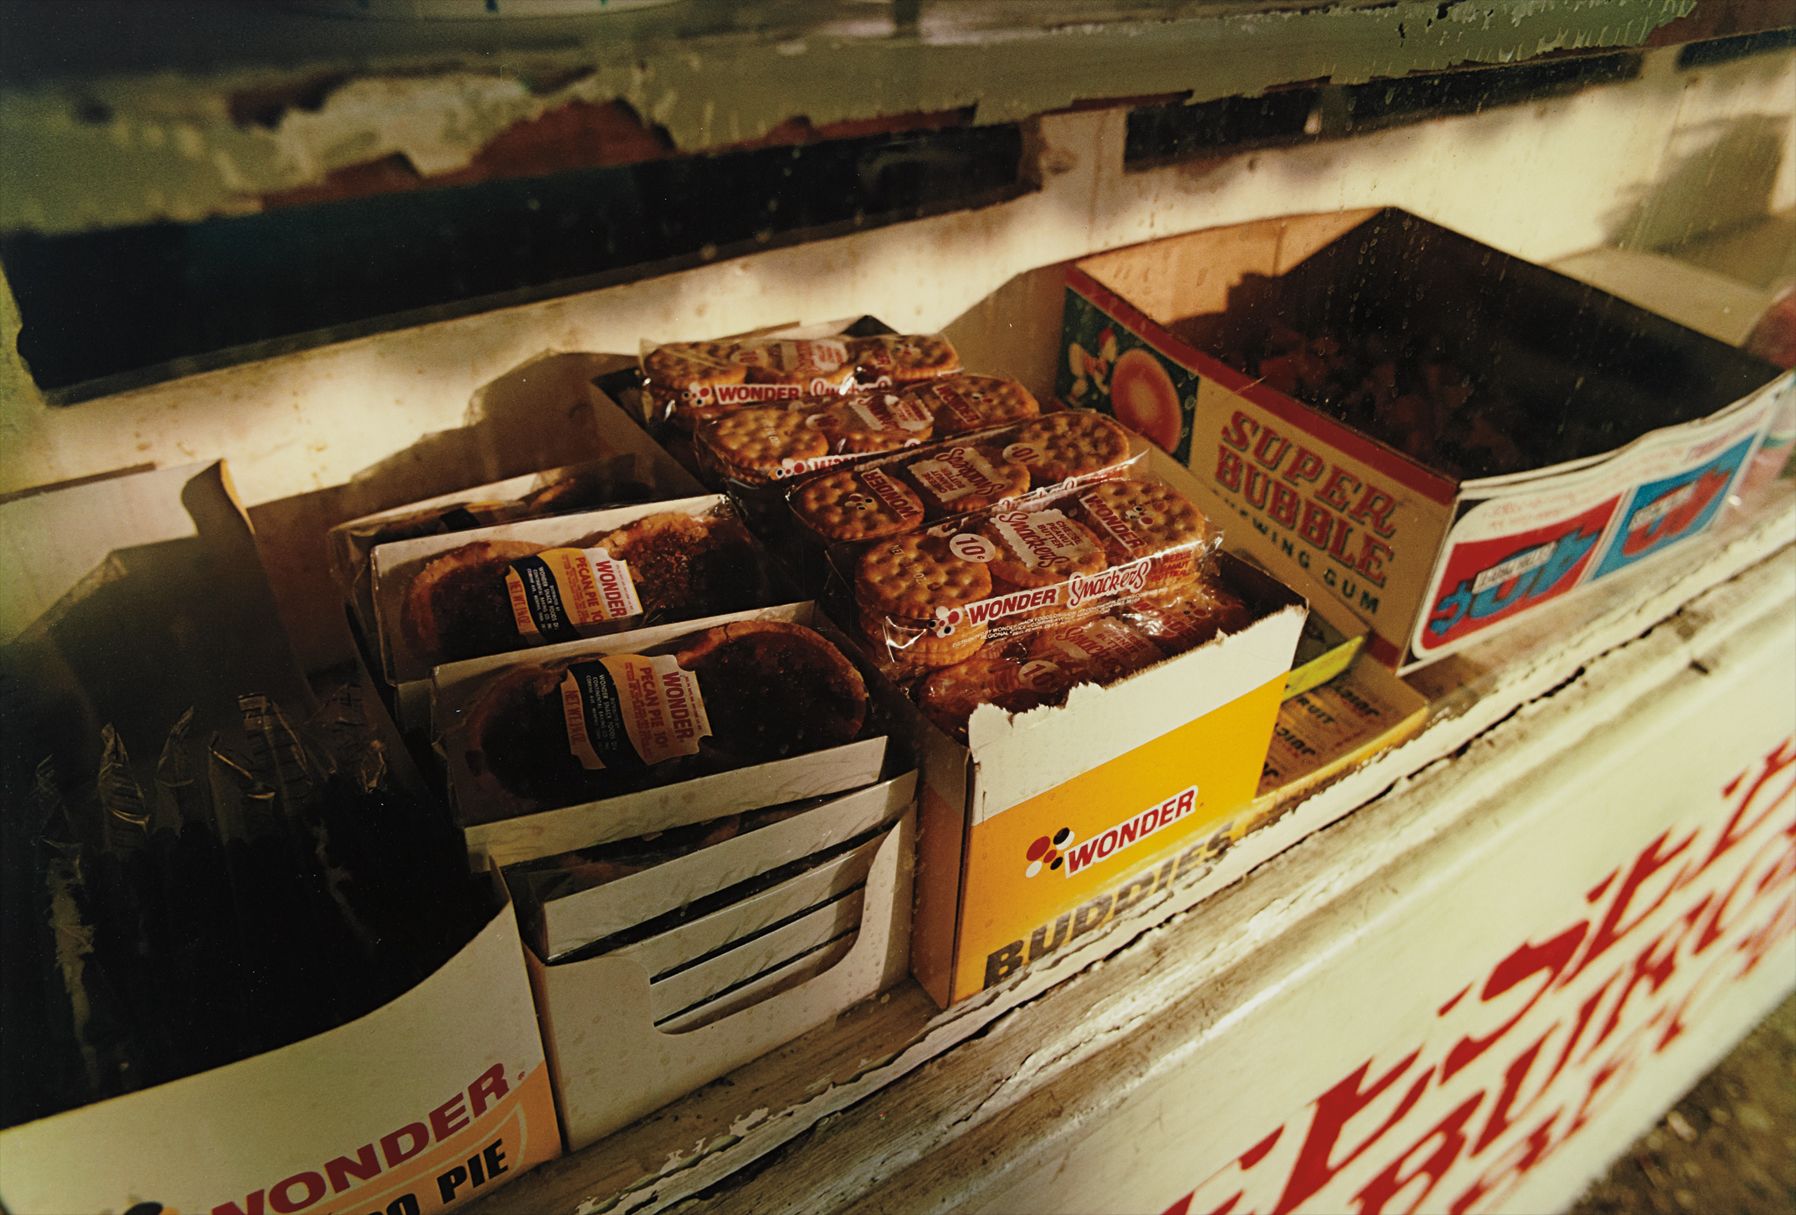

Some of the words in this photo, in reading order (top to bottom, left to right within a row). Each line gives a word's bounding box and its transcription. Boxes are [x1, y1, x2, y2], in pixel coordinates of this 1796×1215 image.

[719, 386, 800, 402] WONDER
[864, 471, 922, 521] WONDER
[1221, 410, 1397, 539] SUPER
[999, 512, 1068, 568] Smackers
[1037, 524, 1065, 550] BUTTER
[1046, 522, 1075, 548] PEANUT
[1055, 519, 1083, 545] CHEESE
[1089, 495, 1148, 549] WONDER
[1215, 443, 1395, 589] BUBBLE
[954, 536, 985, 561] 10¢
[537, 566, 548, 587] WONDER
[575, 556, 594, 589] PECAN
[585, 590, 599, 607] PIE
[595, 561, 627, 618] WONDER
[968, 588, 1057, 625] WONDER
[1069, 560, 1150, 607] Smackers
[1323, 567, 1380, 614] GUM
[598, 674, 608, 699] WONDER
[639, 667, 659, 706] PECAN
[662, 671, 695, 741] WONDER
[647, 708, 664, 727] PIE
[1067, 788, 1196, 874] WONDER
[436, 1138, 511, 1204] PIE
